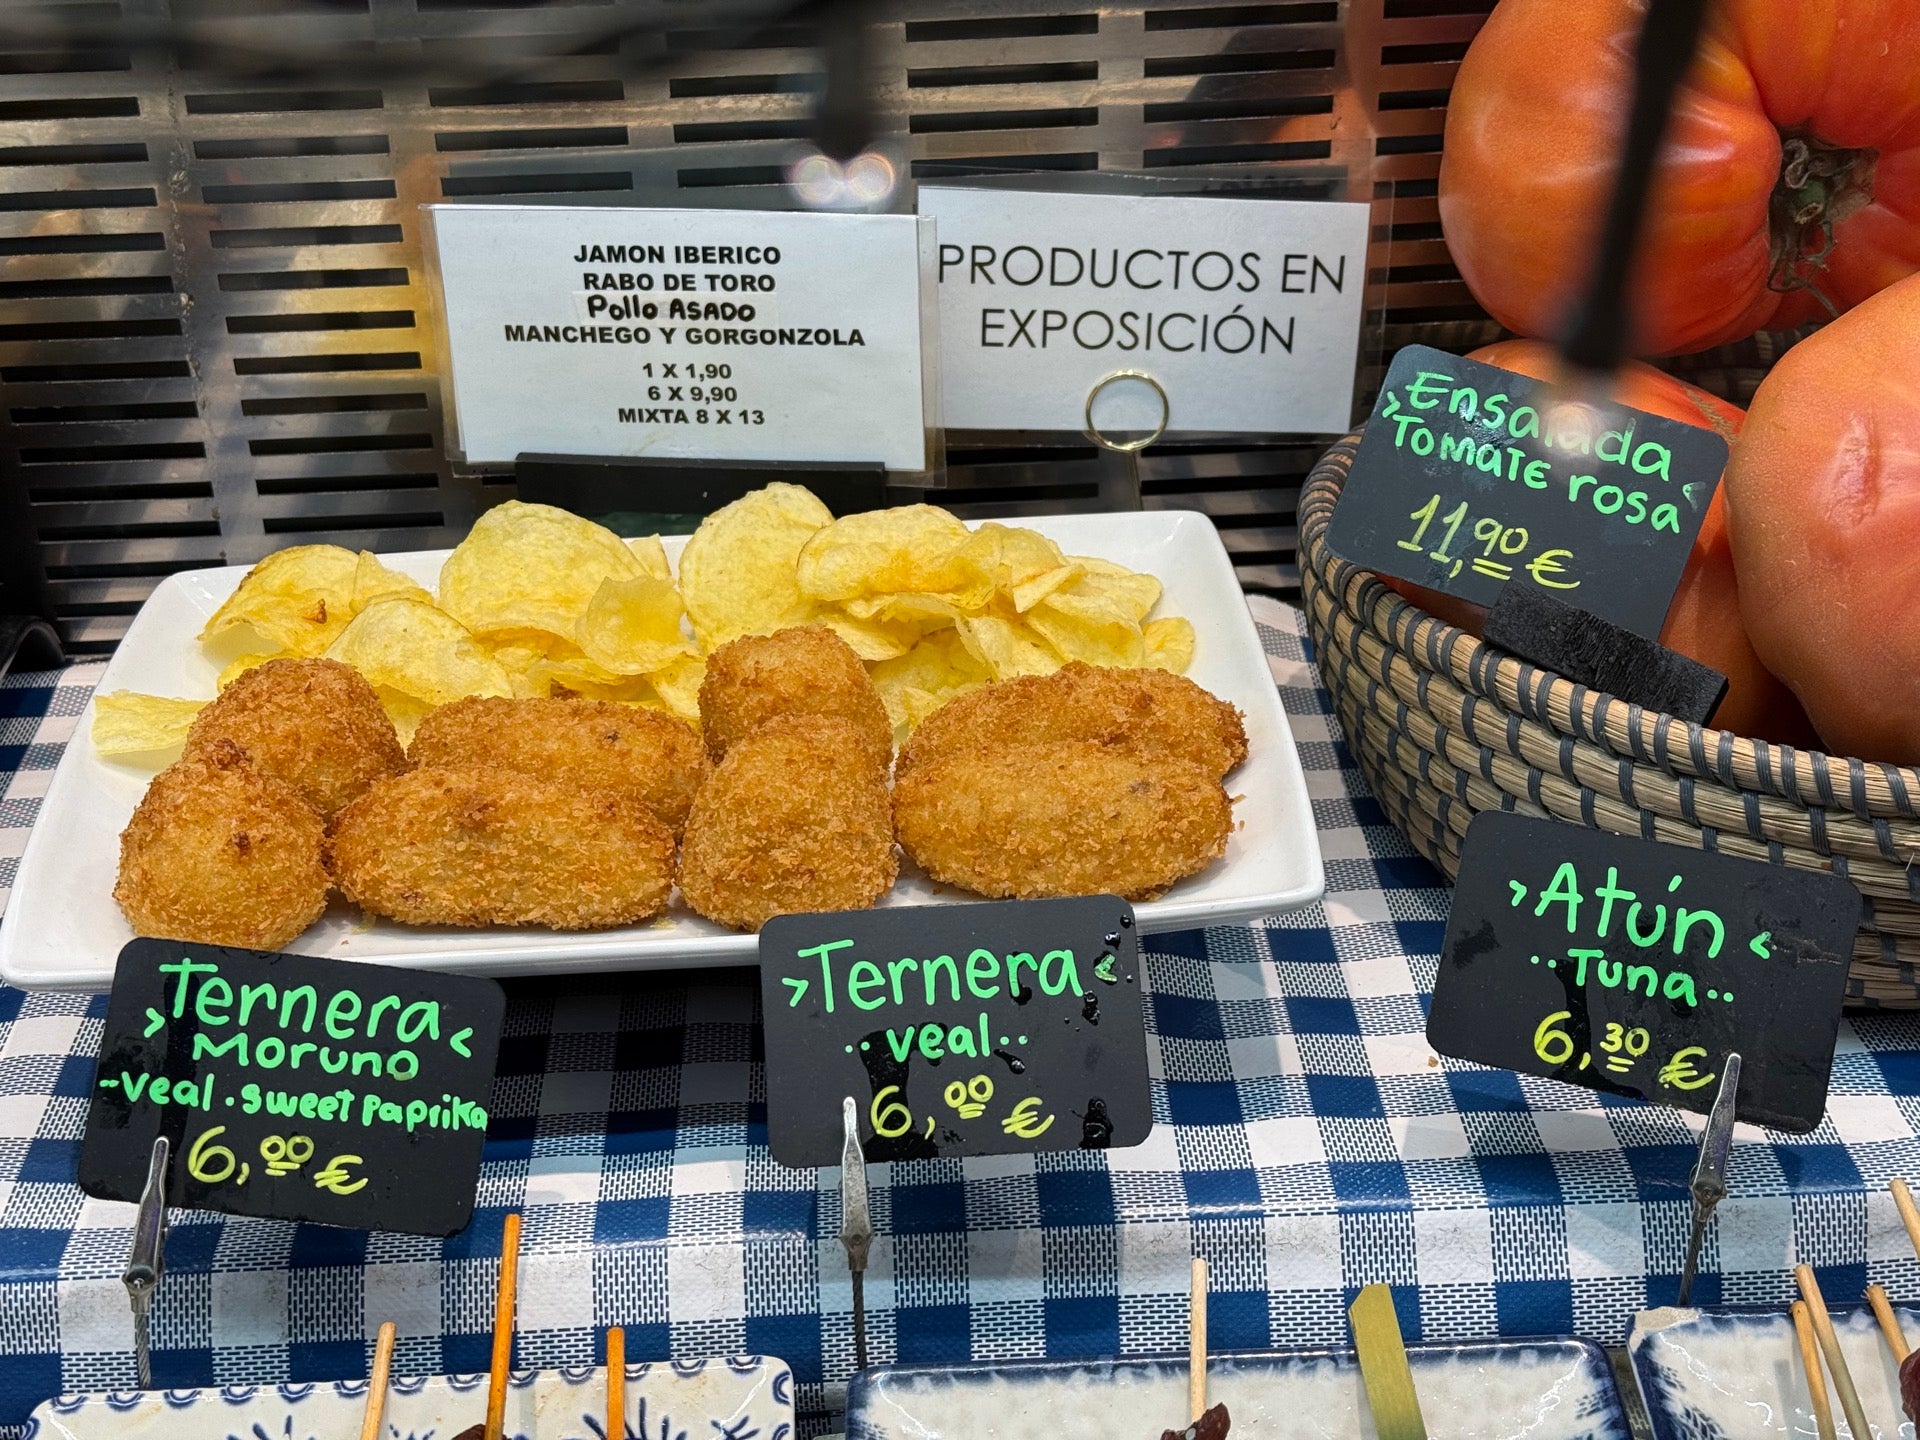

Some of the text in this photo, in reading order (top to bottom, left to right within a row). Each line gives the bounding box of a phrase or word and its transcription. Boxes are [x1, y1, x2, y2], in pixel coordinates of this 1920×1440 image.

[573, 244, 781, 265] JAMON IBERICO
[938, 244, 1346, 294] PRODUCTOS EN
[583, 272, 776, 292] RABO DE TORO
[586, 294, 659, 321] Pollo
[981, 304, 1295, 355] EXPOSICIÓN
[504, 324, 866, 347] MANCHEGO Y GORGONZOLA
[642, 362, 732, 382] 1 X 1,90
[647, 385, 738, 405] 6 X 9,90
[617, 408, 765, 425] MIXTA 8 X 13
[1568, 474, 1680, 534] rosa
[1525, 549, 1582, 589] €
[1533, 862, 1725, 959] Atún
[797, 938, 1084, 1013] Ternera
[158, 957, 441, 1044] Ternera
[192, 1032, 420, 1081] Moruno
[1533, 1010, 1716, 1091] 6,30 €
[870, 1073, 1056, 1140] 6,00 €
[187, 1125, 369, 1196] 6,00 €
